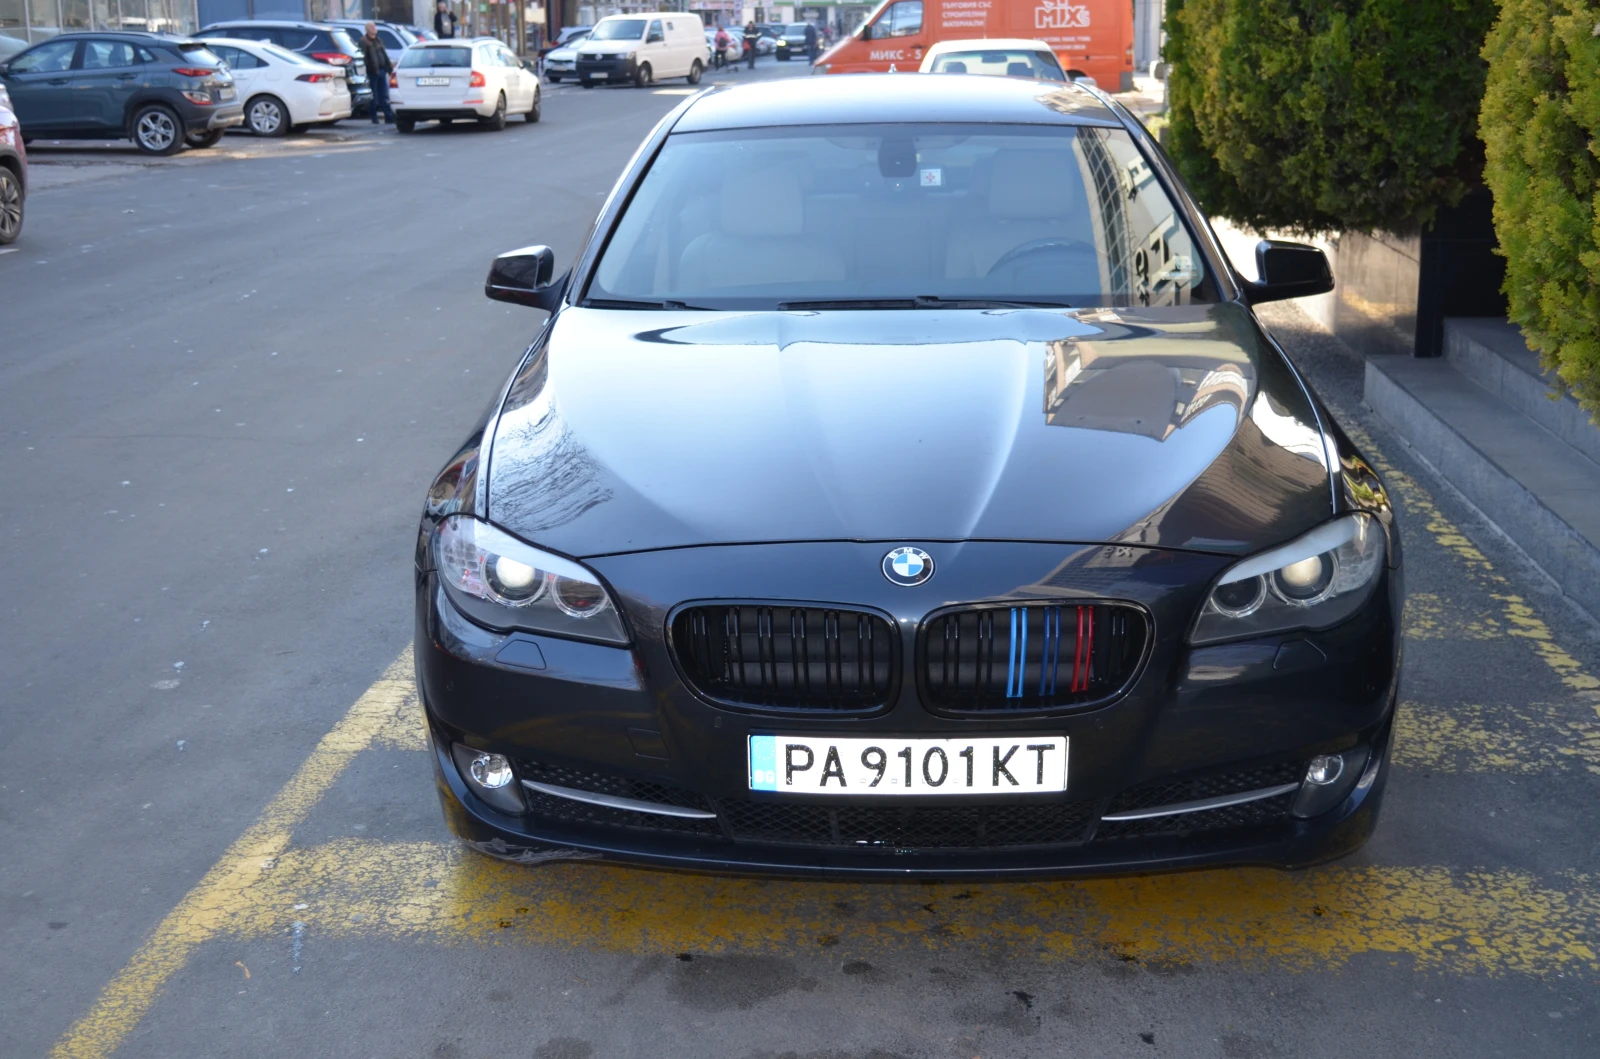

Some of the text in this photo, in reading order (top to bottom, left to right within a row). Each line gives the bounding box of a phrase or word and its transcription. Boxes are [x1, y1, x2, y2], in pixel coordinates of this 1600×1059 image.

[870, 50, 904, 61] МИКС
[887, 547, 930, 560] BMW
[754, 770, 775, 783] BG
